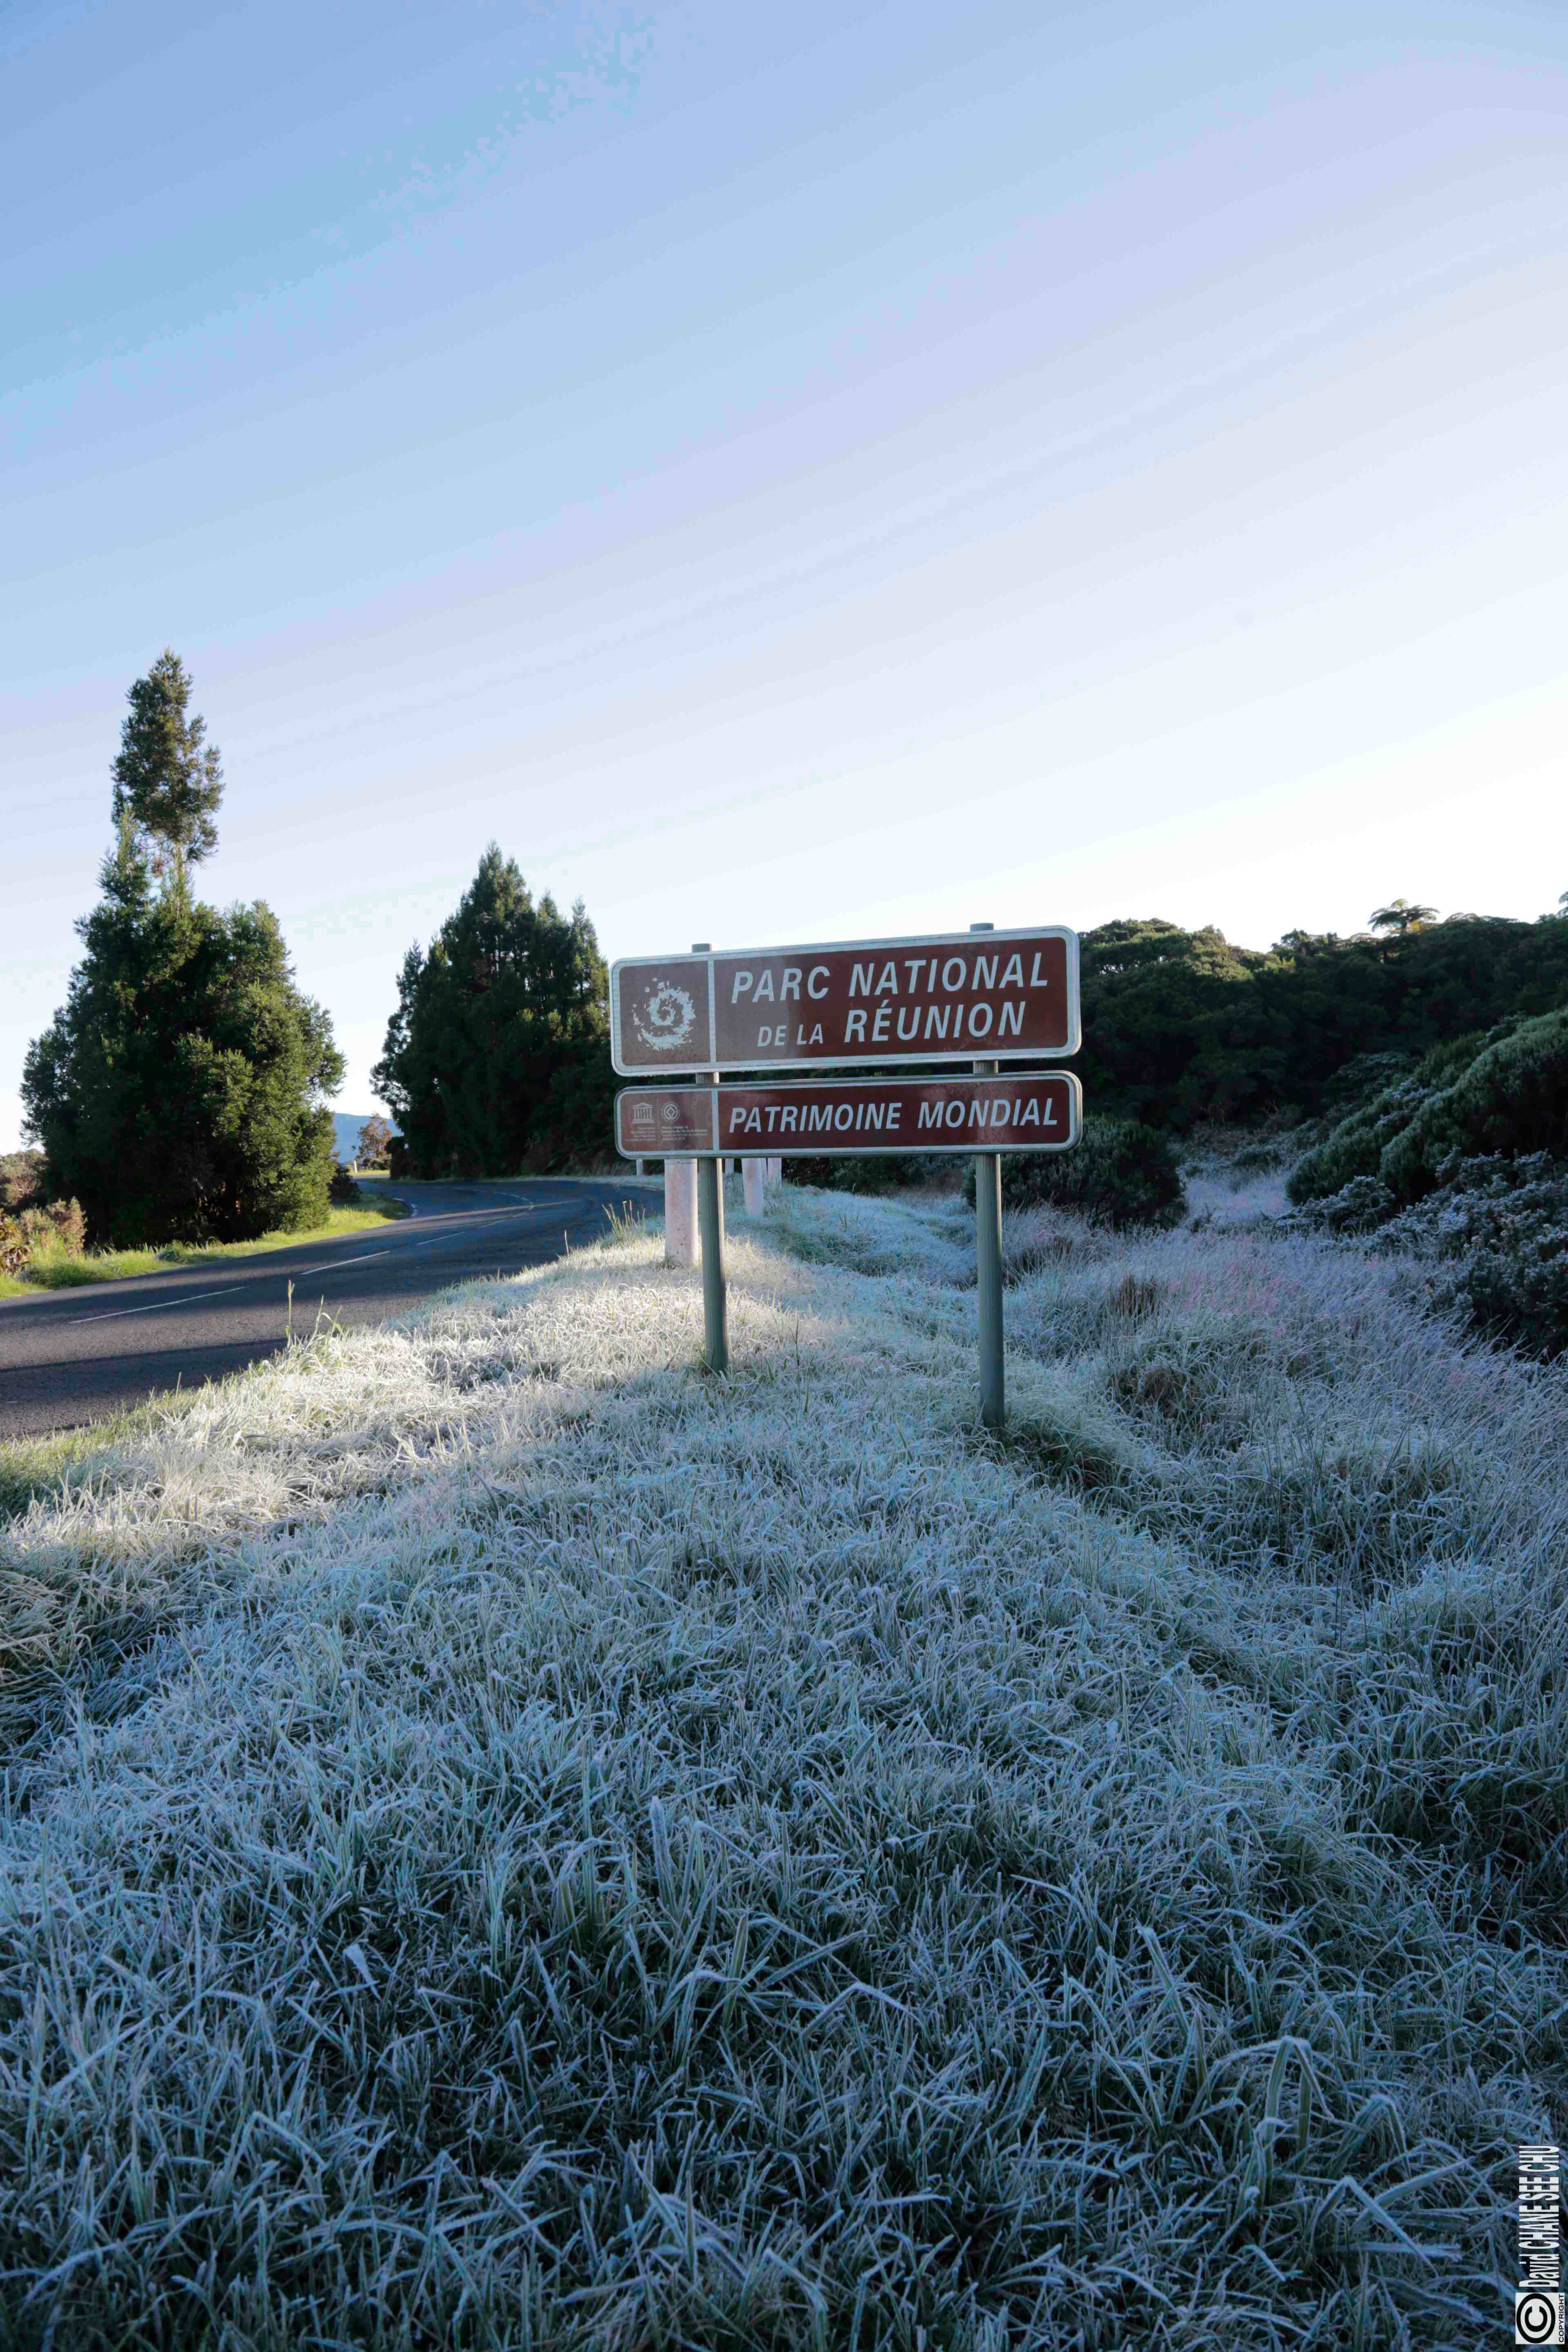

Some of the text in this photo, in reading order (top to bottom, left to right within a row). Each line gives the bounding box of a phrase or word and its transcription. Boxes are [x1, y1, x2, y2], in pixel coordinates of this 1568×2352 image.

[731, 952, 1048, 1004] PARC NATIONAL
[757, 1000, 1026, 1047] DE LA RÉUNION
[728, 1098, 1058, 1133] PATRIMOINE MONDIAL
